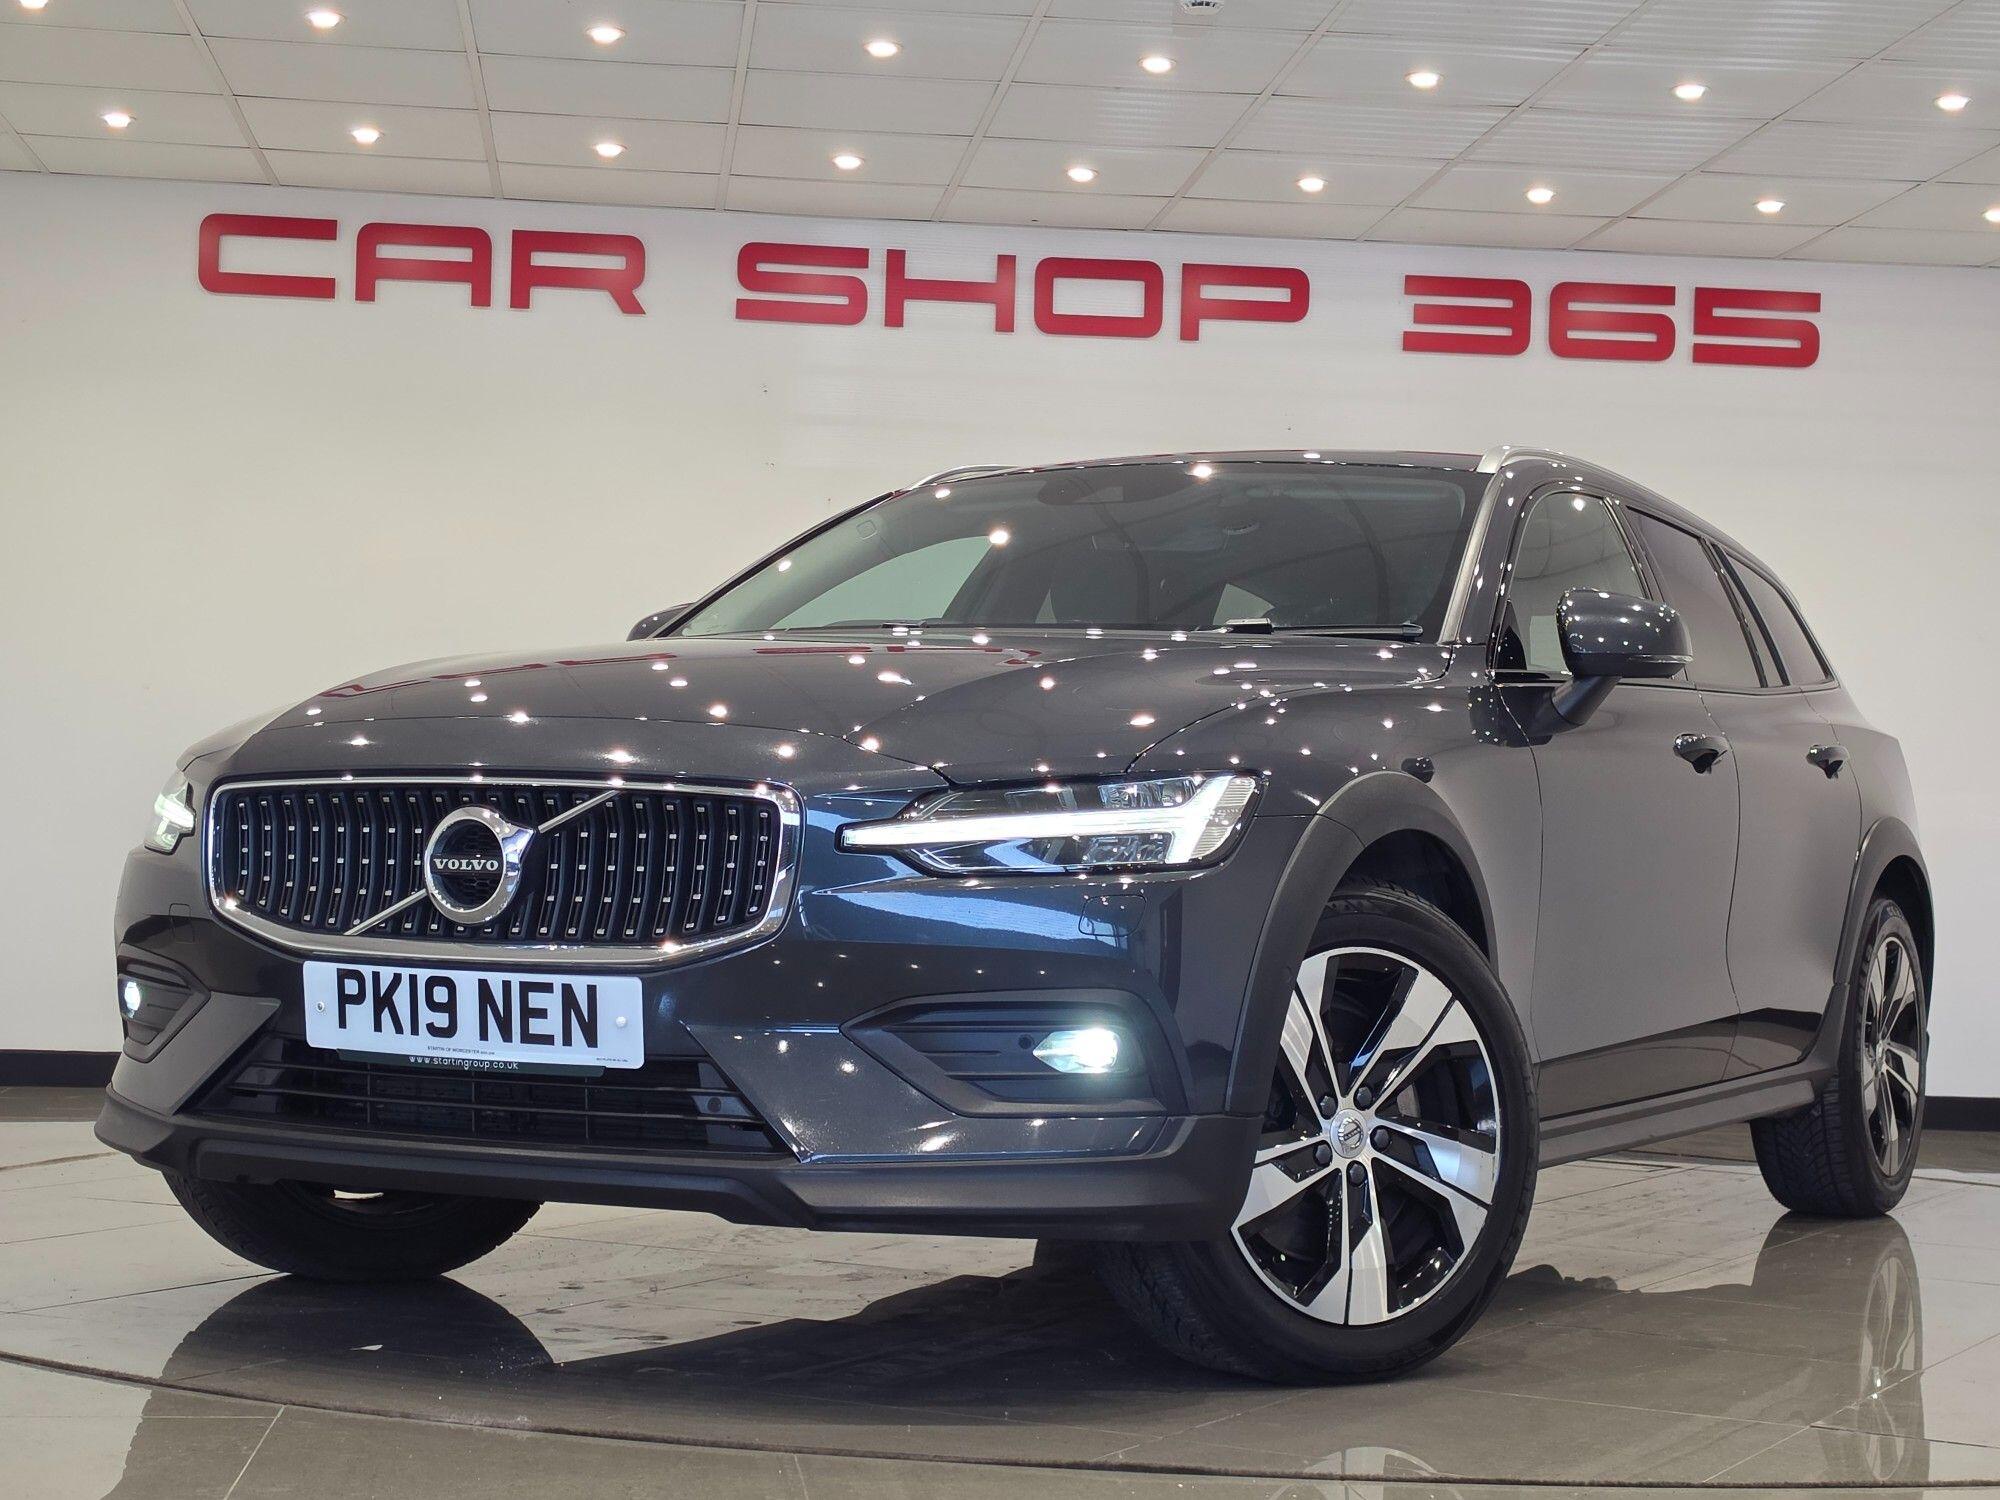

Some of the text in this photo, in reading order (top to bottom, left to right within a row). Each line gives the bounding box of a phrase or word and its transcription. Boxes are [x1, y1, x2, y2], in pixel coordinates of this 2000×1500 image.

[199, 213, 1822, 369] CAR SHOP 365
[433, 858, 499, 871] VOLVO
[336, 967, 599, 1049] PK19 NEN
[408, 1056, 519, 1071] www.startingroup.co.uk
